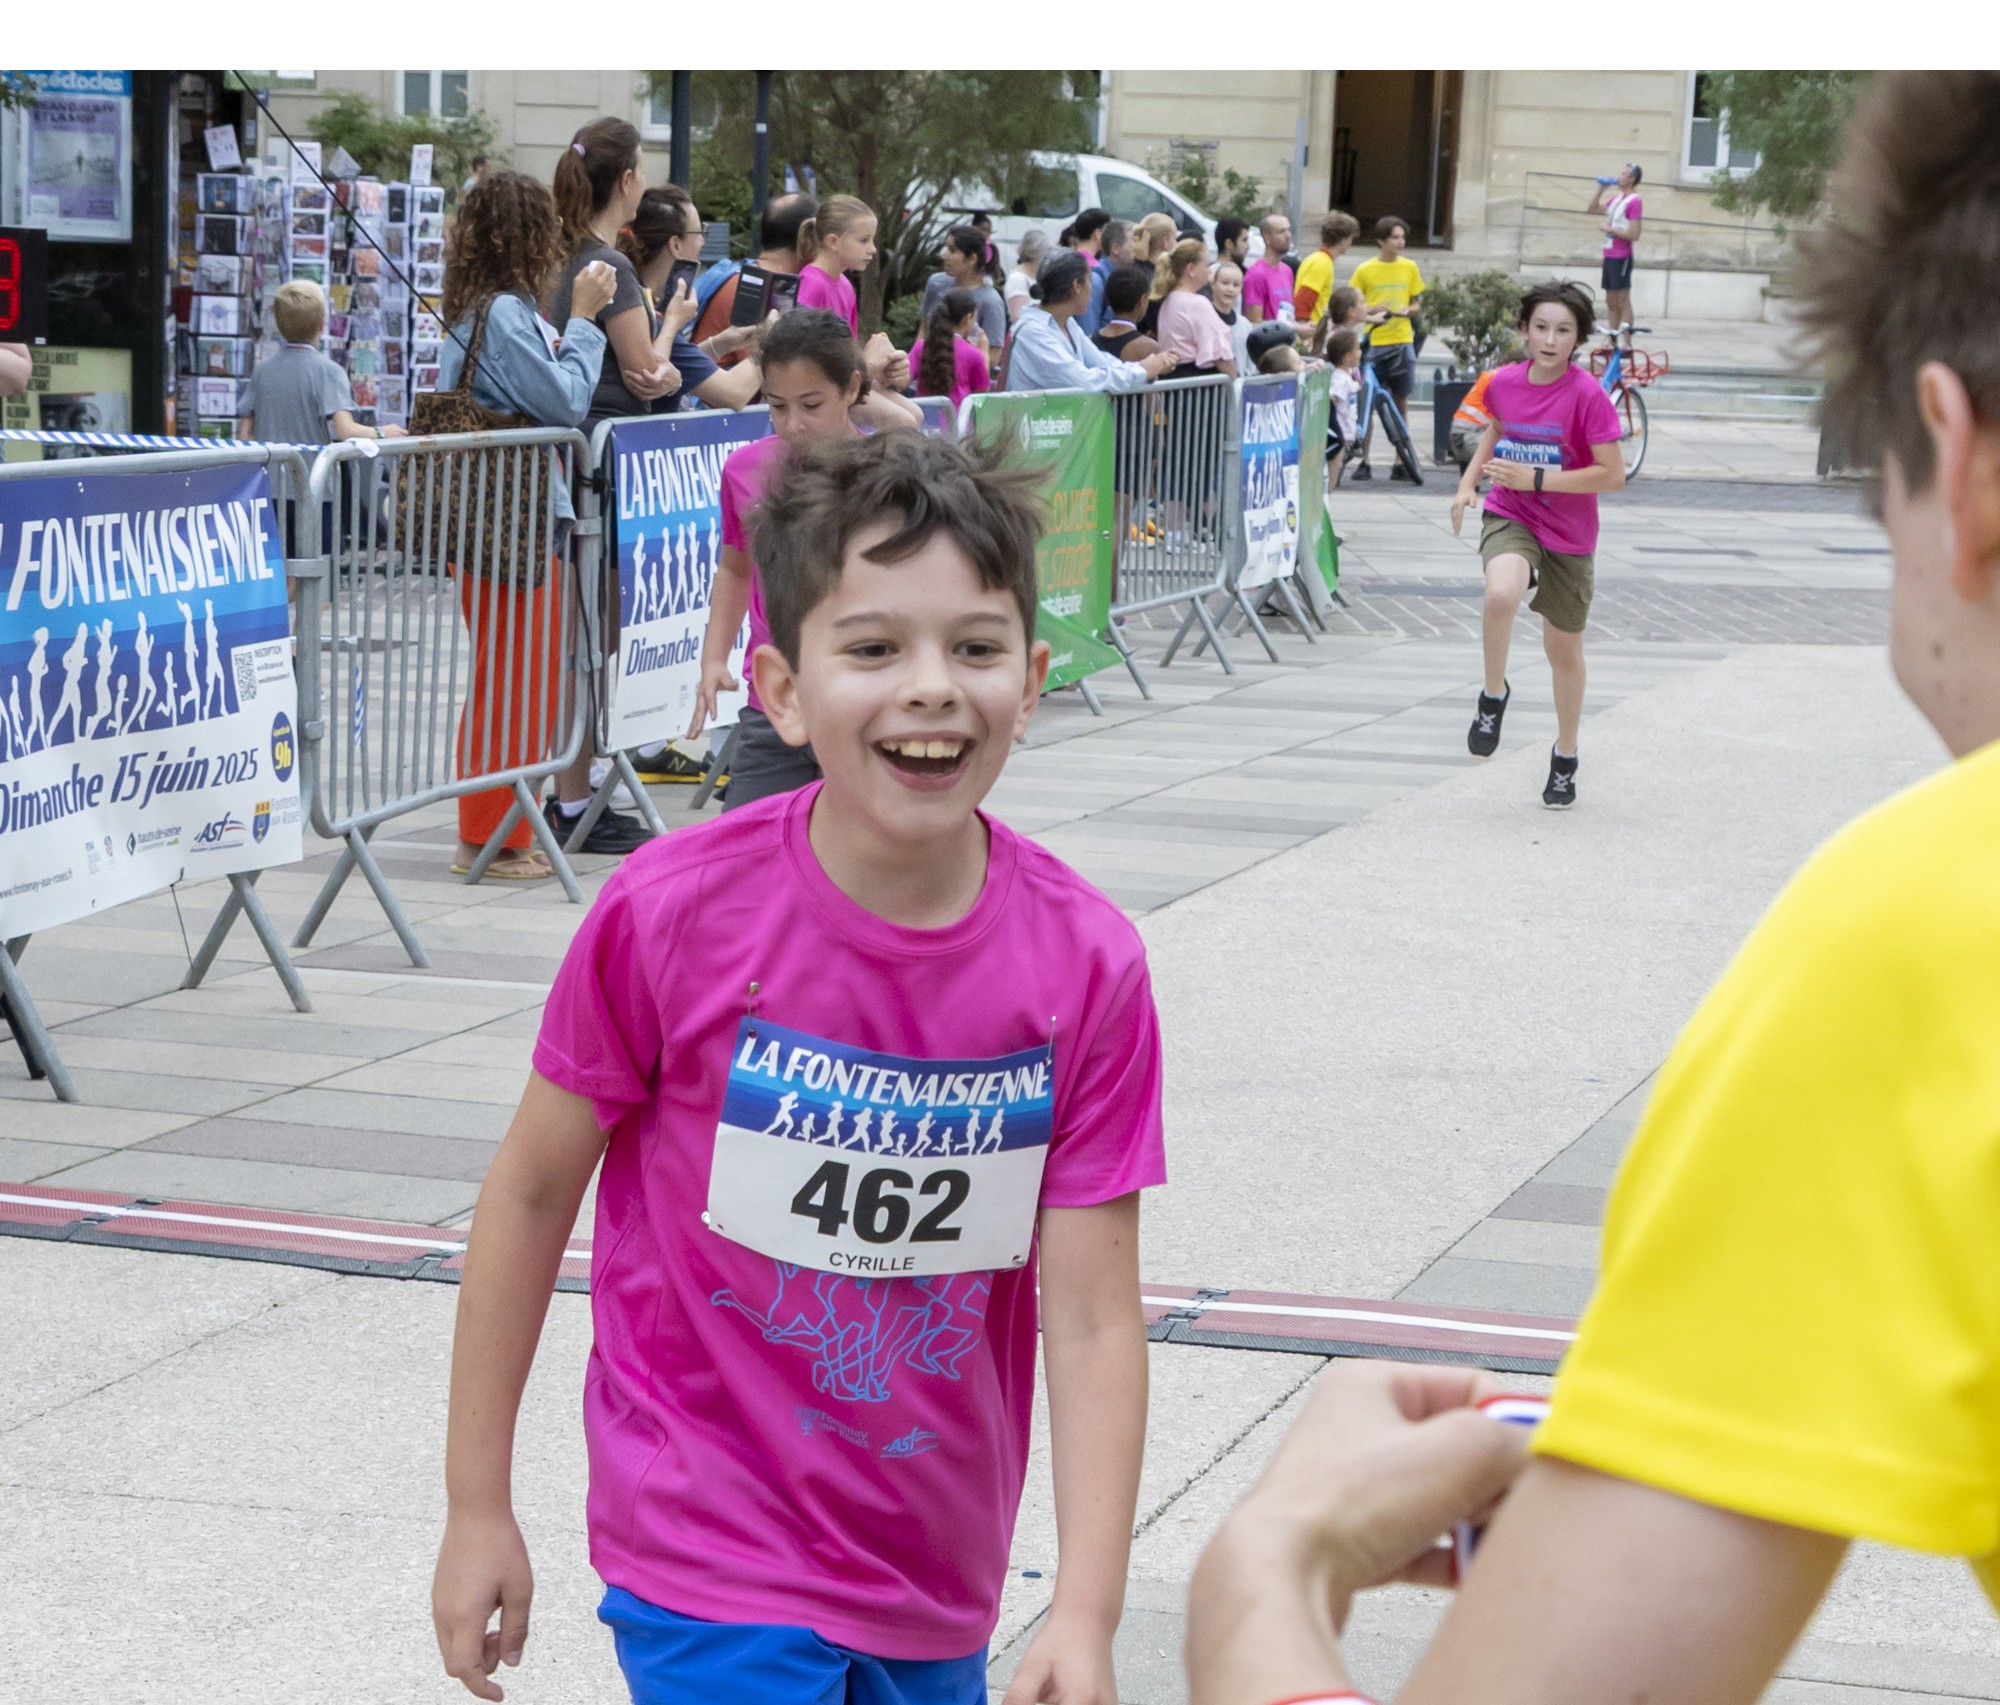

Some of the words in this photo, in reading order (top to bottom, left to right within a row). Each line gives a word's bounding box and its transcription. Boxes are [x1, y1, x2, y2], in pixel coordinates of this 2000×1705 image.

[620, 451, 646, 520] LA
[6, 498, 274, 611] FONTENAISIENNE
[625, 627, 699, 677] Dimanche
[275, 741, 292, 770] 9h
[0, 763, 104, 835] Dimanche
[110, 751, 149, 804] 15
[139, 746, 209, 810] juin
[211, 748, 259, 788] 2025
[736, 1037, 780, 1078] LA
[783, 1046, 1050, 1107] FONTENAISIENNE
[790, 1159, 970, 1244] 462
[829, 1251, 916, 1272] CYRILLE
